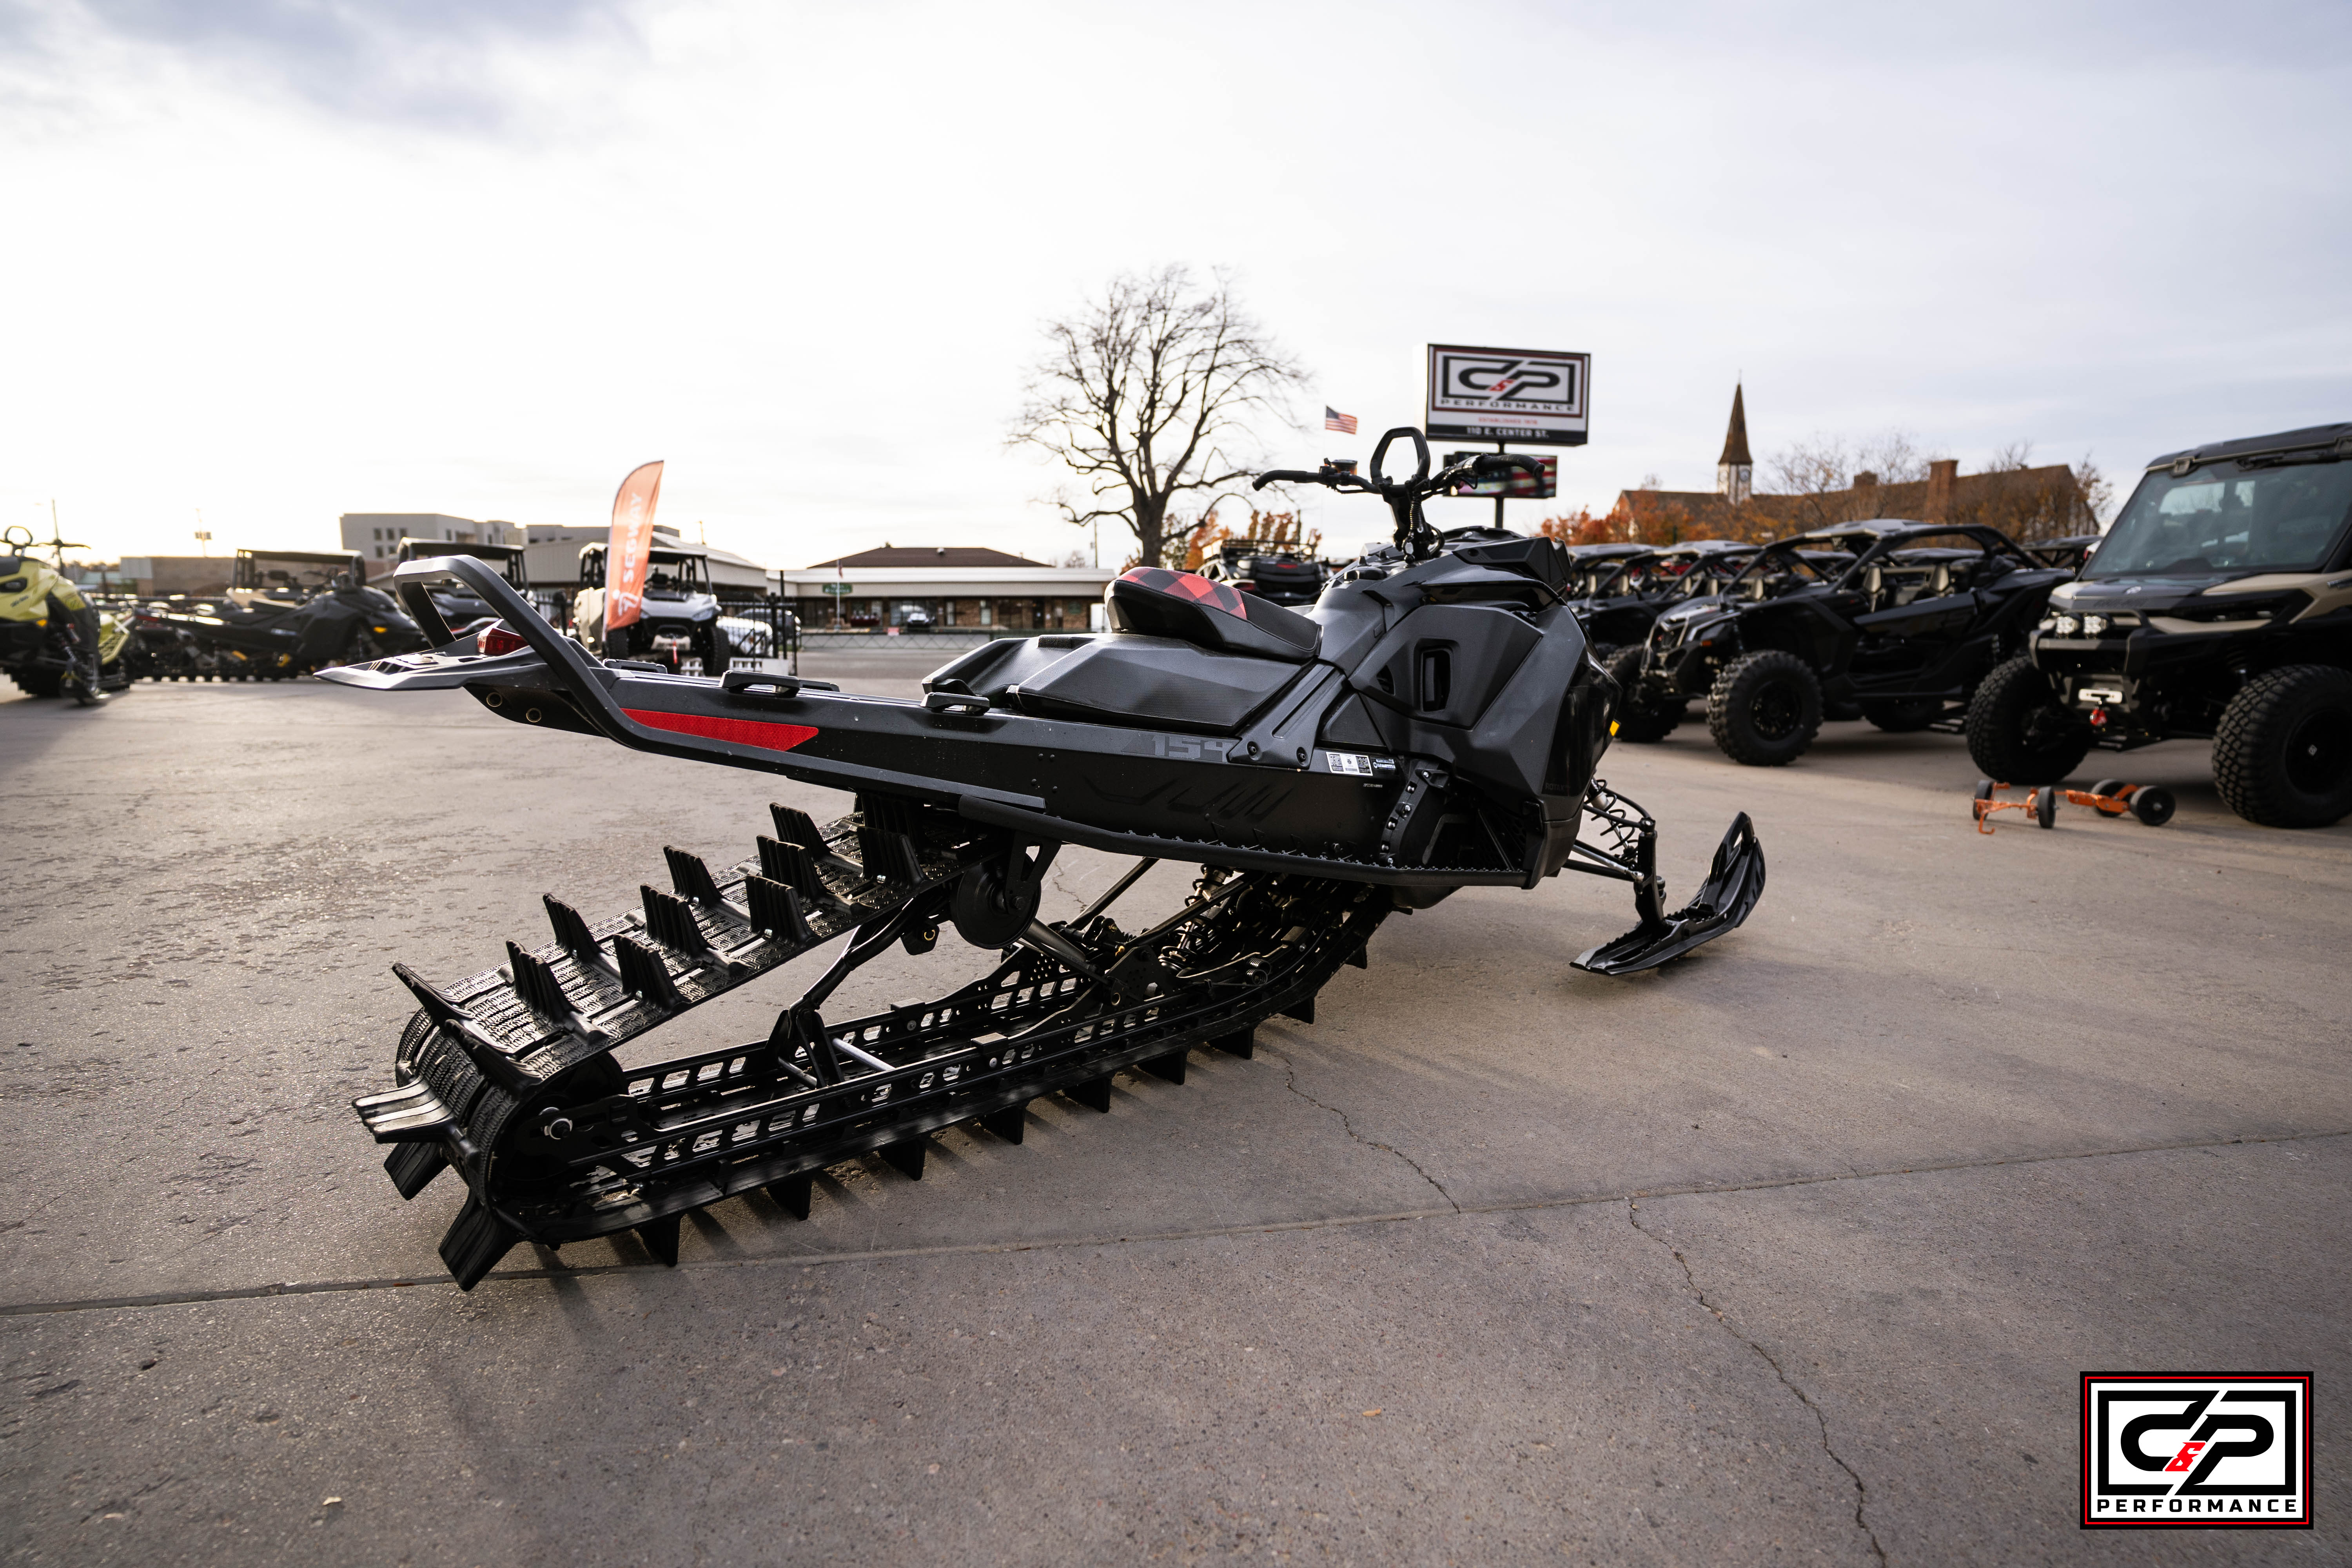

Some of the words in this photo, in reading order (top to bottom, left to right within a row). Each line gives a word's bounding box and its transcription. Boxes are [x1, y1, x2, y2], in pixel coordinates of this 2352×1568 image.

[1441, 399, 1575, 411] PERFORMANCE
[1467, 427, 1482, 435] 110
[1484, 427, 1494, 436] E.
[1496, 428, 1533, 437] CENTER
[1534, 430, 1549, 438] ST.
[623, 493, 642, 583] SEGWAY
[1152, 735, 1234, 762] 154
